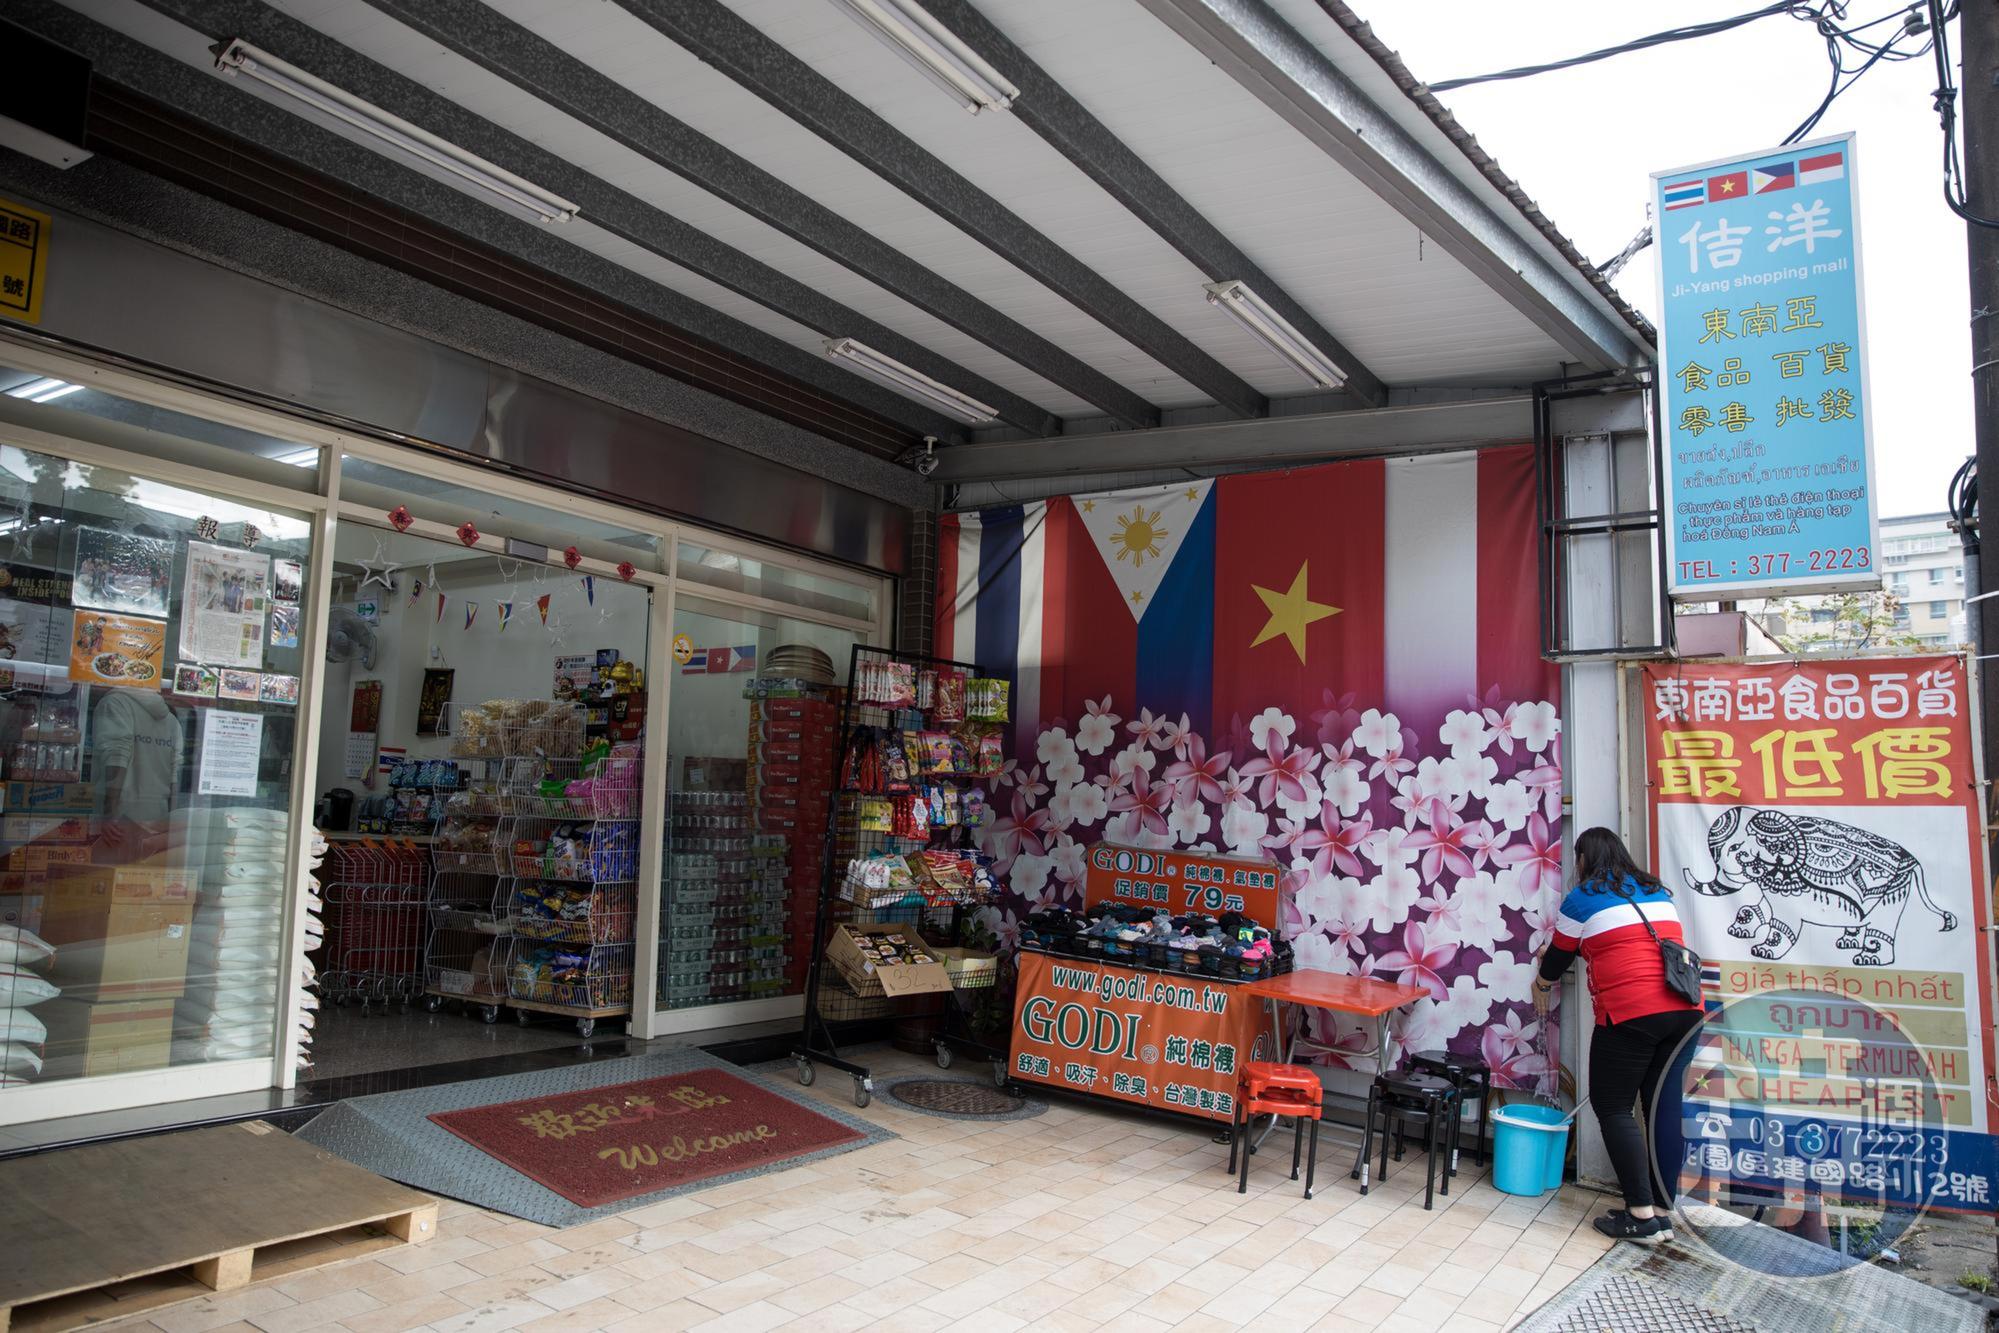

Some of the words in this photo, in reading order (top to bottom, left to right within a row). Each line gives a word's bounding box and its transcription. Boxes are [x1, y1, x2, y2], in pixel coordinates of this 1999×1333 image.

[1678, 199, 1843, 273] 佶洋
[1672, 278, 1730, 297] Ji-Yang
[1734, 266, 1808, 288] shopping
[1813, 257, 1847, 273] mall
[1698, 296, 1823, 344] 東南亞
[1677, 357, 1750, 393] 食品
[1772, 342, 1851, 379] 百貨
[1679, 402, 1754, 437] 零售
[1775, 387, 1856, 428] 批發
[1678, 498, 1731, 515] Chuyên
[1766, 508, 1784, 521] và
[1786, 505, 1824, 521] hàng
[1751, 521, 1785, 537] Nam
[1748, 547, 1871, 577] 377-2223
[1654, 670, 1958, 722] 東南亞食品百貨
[1657, 727, 1954, 799] 最低價
[1092, 848, 1166, 877] GODI
[1114, 879, 1170, 902] 促銷價
[1052, 965, 1228, 1016] www.godi.com.tw
[1729, 966, 1776, 994] giá
[1785, 969, 1863, 998] thấp
[1874, 973, 1954, 1001] nhất
[1021, 995, 1142, 1061] GODI
[1769, 1003, 1901, 1033] ถูกมาก
[1165, 1035, 1236, 1076] 純棉襪
[1728, 1036, 1803, 1067] HARGA
[1823, 1043, 1957, 1080] TERMURAH
[1736, 1075, 1956, 1118] CHEAPEST
[600, 1122, 777, 1170] Welcome
[1749, 1116, 1949, 1165] 03-3772223
